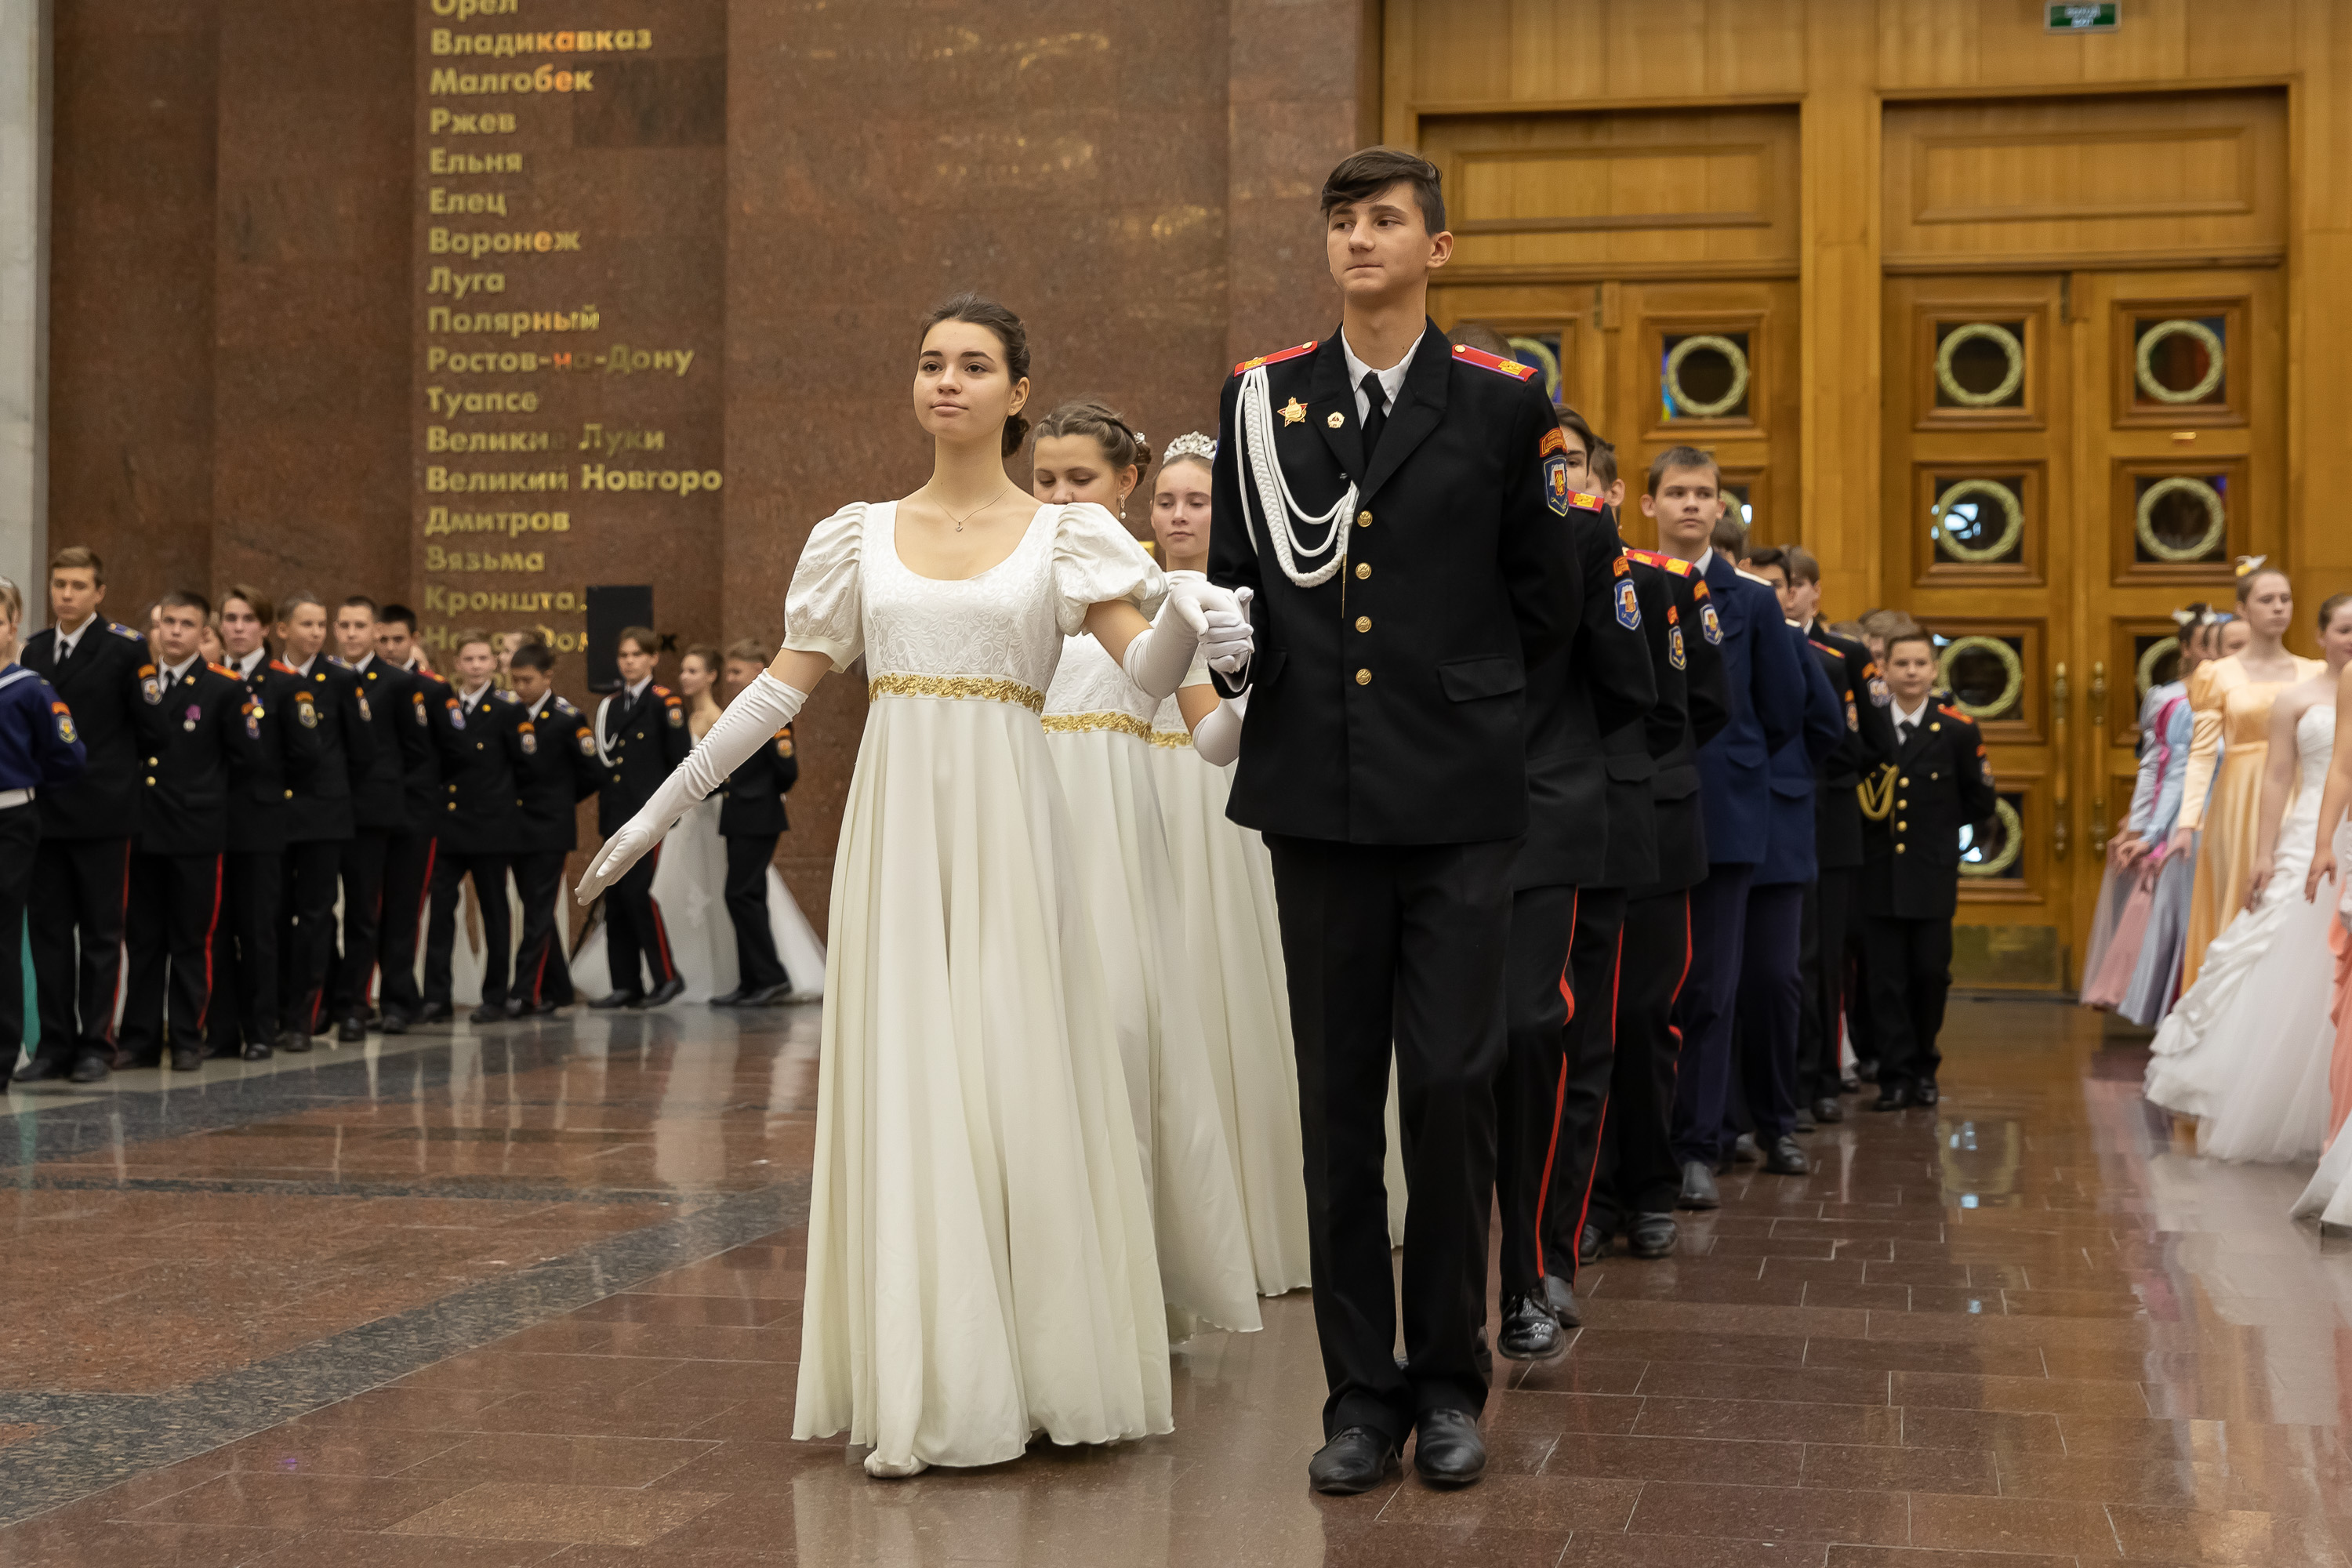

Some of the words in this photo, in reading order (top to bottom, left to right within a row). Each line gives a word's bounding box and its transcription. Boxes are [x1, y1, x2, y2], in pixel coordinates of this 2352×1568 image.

[430, 28, 653, 57] Владикавказ
[429, 64, 594, 95] Малгобек
[429, 107, 517, 135] Ржев
[429, 147, 523, 175] Ельня
[428, 187, 508, 217] Елец
[428, 227, 581, 260] Воронеж
[427, 266, 506, 299] Луга
[427, 304, 601, 338] Полярный
[427, 345, 695, 376] Ростов-на-Дону
[426, 386, 539, 419] Туапсе
[579, 423, 665, 457] Луки
[426, 463, 569, 492] Великий
[580, 463, 723, 496] Новгоро
[424, 506, 571, 538] Дмитров
[424, 546, 546, 572] Вязьма
